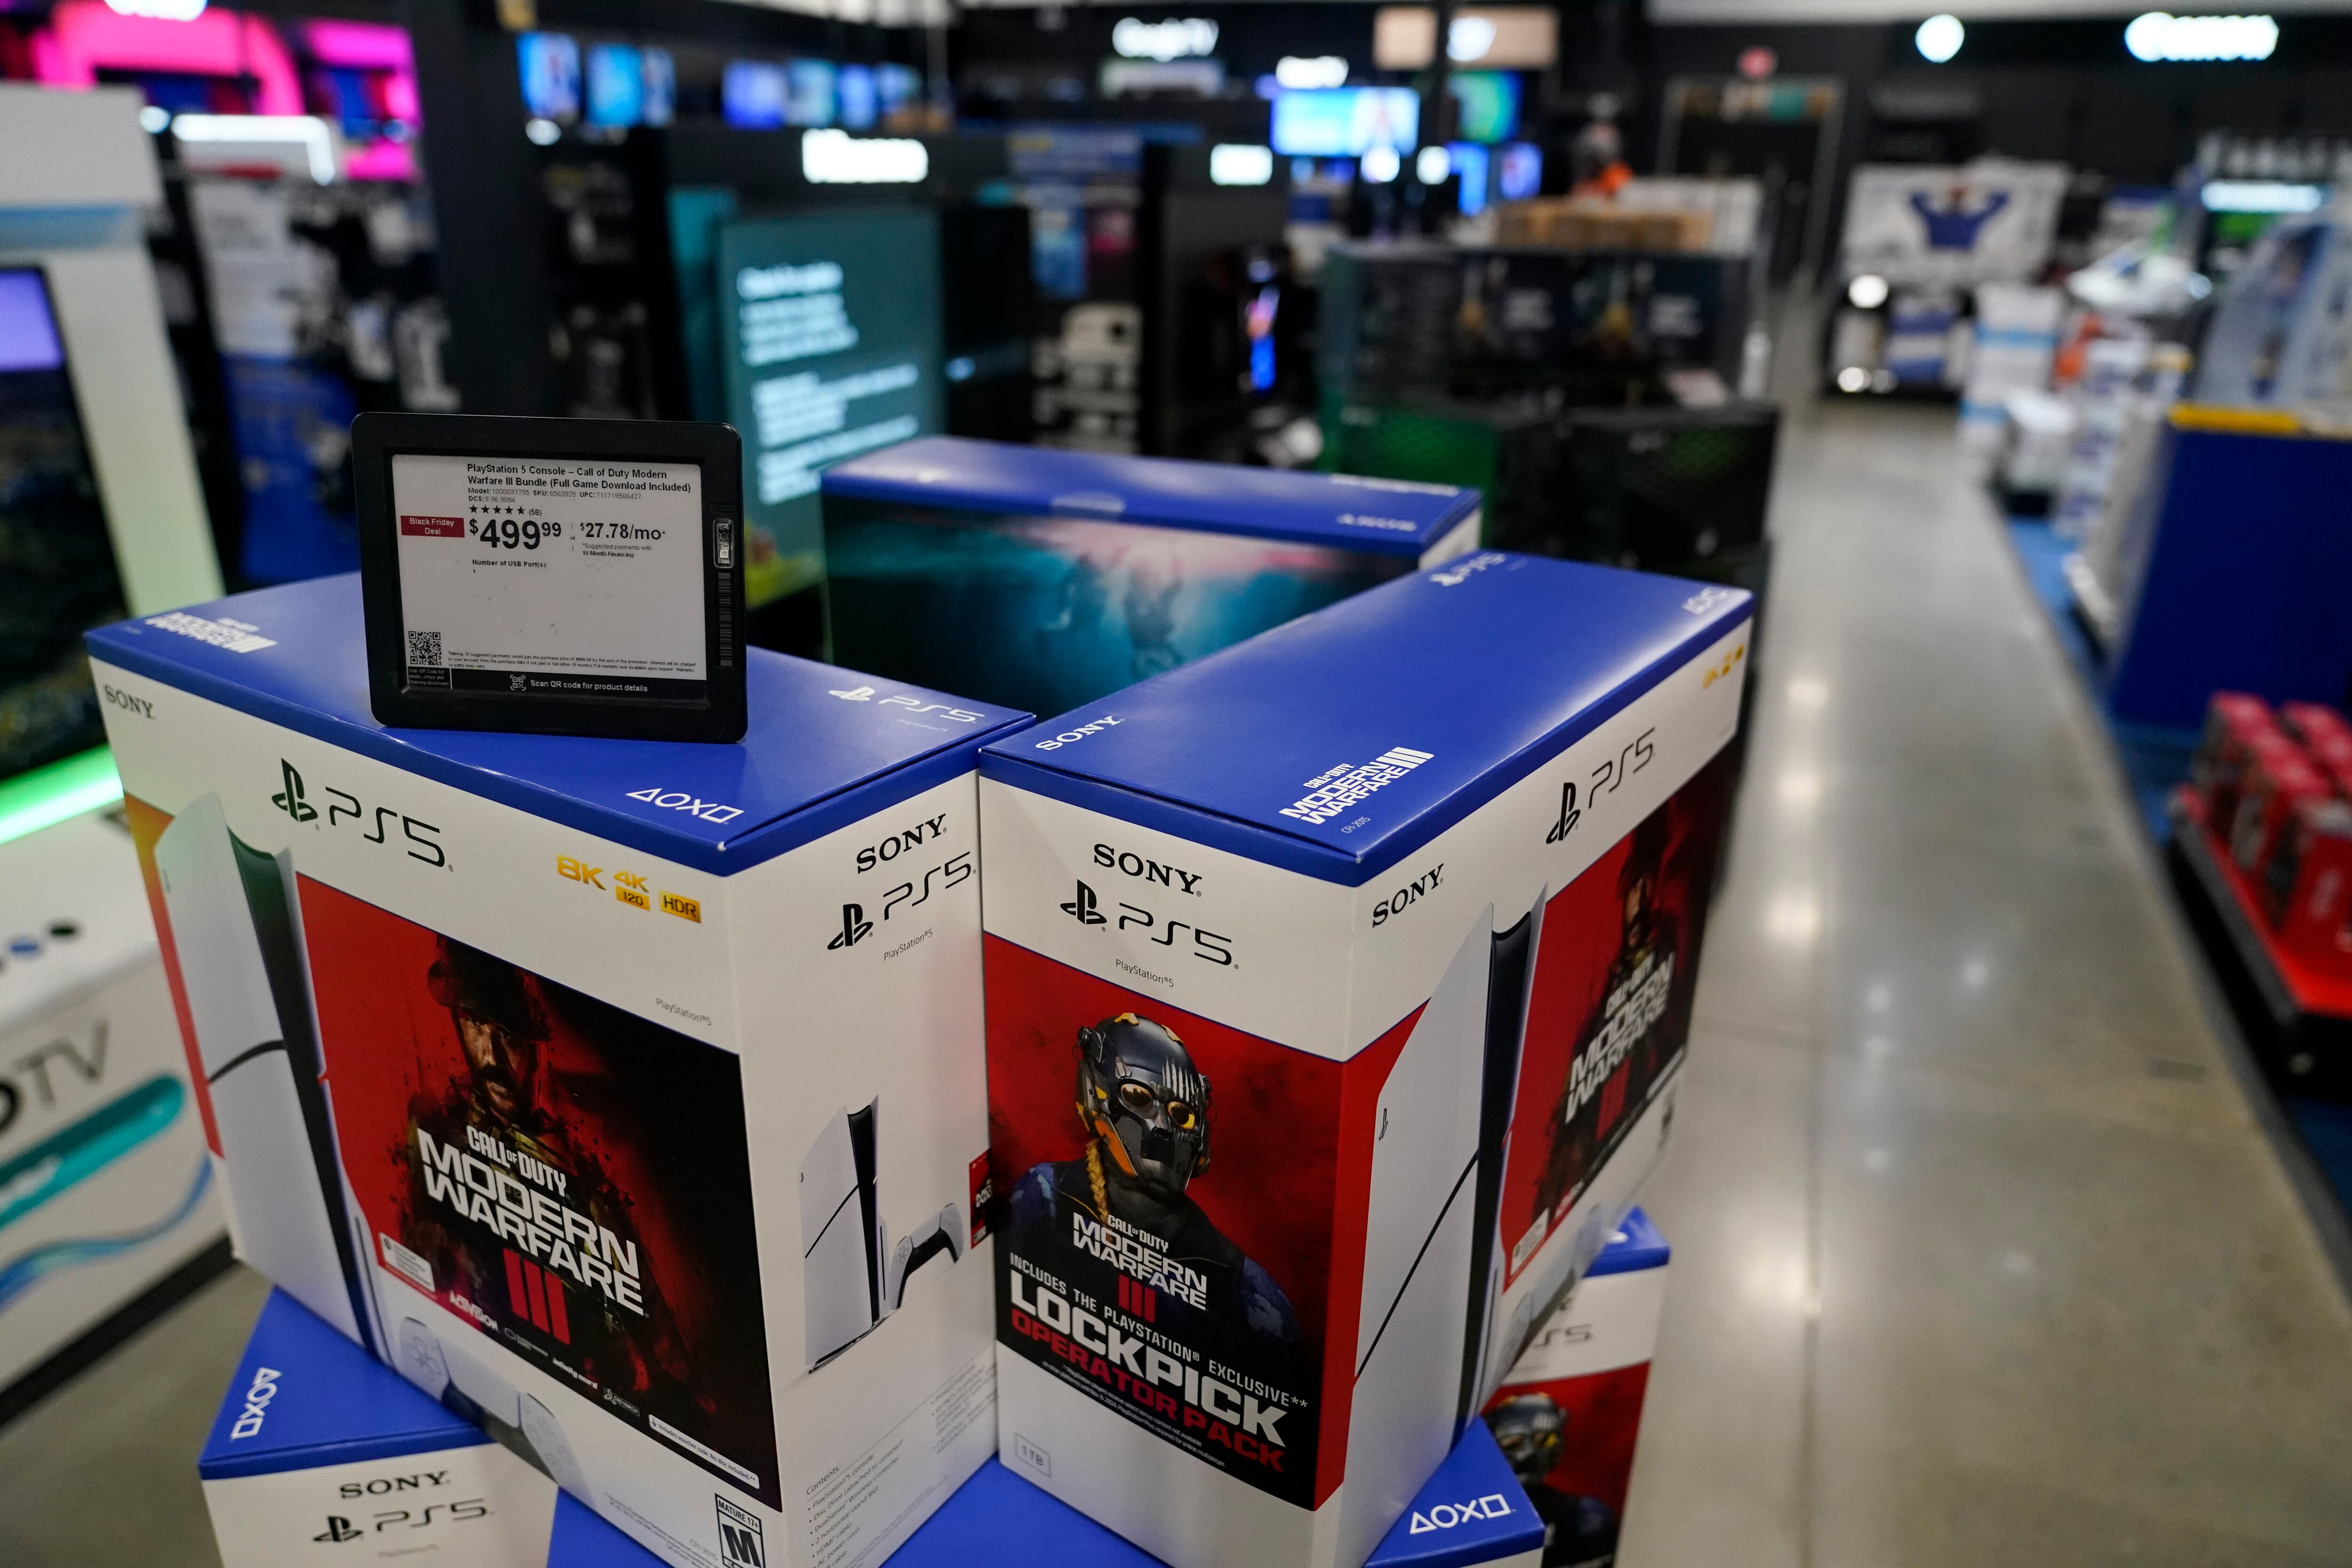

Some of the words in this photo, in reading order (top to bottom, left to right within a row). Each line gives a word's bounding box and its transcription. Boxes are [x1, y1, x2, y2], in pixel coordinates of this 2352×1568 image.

[468, 464, 517, 474] PlayStation
[529, 466, 565, 475] Console
[608, 469, 629, 479] Duty
[632, 470, 667, 478] Modern
[468, 476, 502, 485] Warfare
[516, 478, 547, 486] Bundle
[550, 479, 569, 488] (Full
[602, 480, 646, 490] Download
[649, 482, 691, 493] Included)
[432, 518, 454, 527] Friday
[103, 683, 154, 719] SONY
[878, 695, 985, 722] PS5
[1035, 716, 1120, 750] SONY
[1303, 773, 1332, 788] CALL
[1327, 763, 1355, 777] DUTY
[1588, 726, 1655, 810] PS5
[1279, 762, 1390, 819] MODERN
[1300, 766, 1410, 825] WARFARE
[326, 786, 445, 867] PS5
[856, 813, 946, 874] SONY
[1341, 816, 1371, 834] CFI-2015
[556, 853, 607, 891] 8K
[614, 870, 650, 893] 4K
[663, 895, 697, 917] HDR
[883, 851, 971, 921] PS5
[1094, 844, 1202, 895] SONY
[623, 891, 644, 906] 120
[1372, 863, 1444, 929] SONY
[1119, 902, 1232, 966] PS5
[467, 1125, 511, 1169] CALL
[506, 1148, 518, 1164] OF
[517, 1151, 566, 1197] DUTY
[417, 1128, 640, 1280] MODERN
[423, 1163, 644, 1316] WARFARE
[1073, 1212, 1207, 1294] MODERN
[1108, 1214, 1134, 1237] CALL
[1139, 1229, 1169, 1253] DUTY
[1009, 1252, 1067, 1295] INCLUDES
[1074, 1288, 1097, 1313] THE
[1073, 1229, 1207, 1311] WARFARE
[449, 1290, 499, 1331] ACTIVISION
[1011, 1269, 1287, 1448] LOCKPICK
[1012, 1309, 1177, 1421] OPERATOR
[1184, 1405, 1284, 1472] PACK
[659, 1424, 677, 1439] Includes
[678, 1436, 696, 1449] voucher
[710, 1453, 717, 1462] No
[718, 1459, 727, 1467] disc
[852, 1455, 874, 1475] console
[1022, 1445, 1043, 1466] 1TB
[339, 1470, 449, 1499] SONY
[806, 1465, 839, 1495] Contents
[849, 1481, 872, 1503] Wireless
[373, 1497, 488, 1532] PS5
[718, 1500, 747, 1522] MATURE
[747, 1517, 759, 1528] 17+
[814, 1508, 826, 1520] Disc
[828, 1493, 843, 1509] Drive
[821, 1511, 850, 1539] horizontal
[721, 1523, 762, 1568] M
[827, 1540, 845, 1559] power
